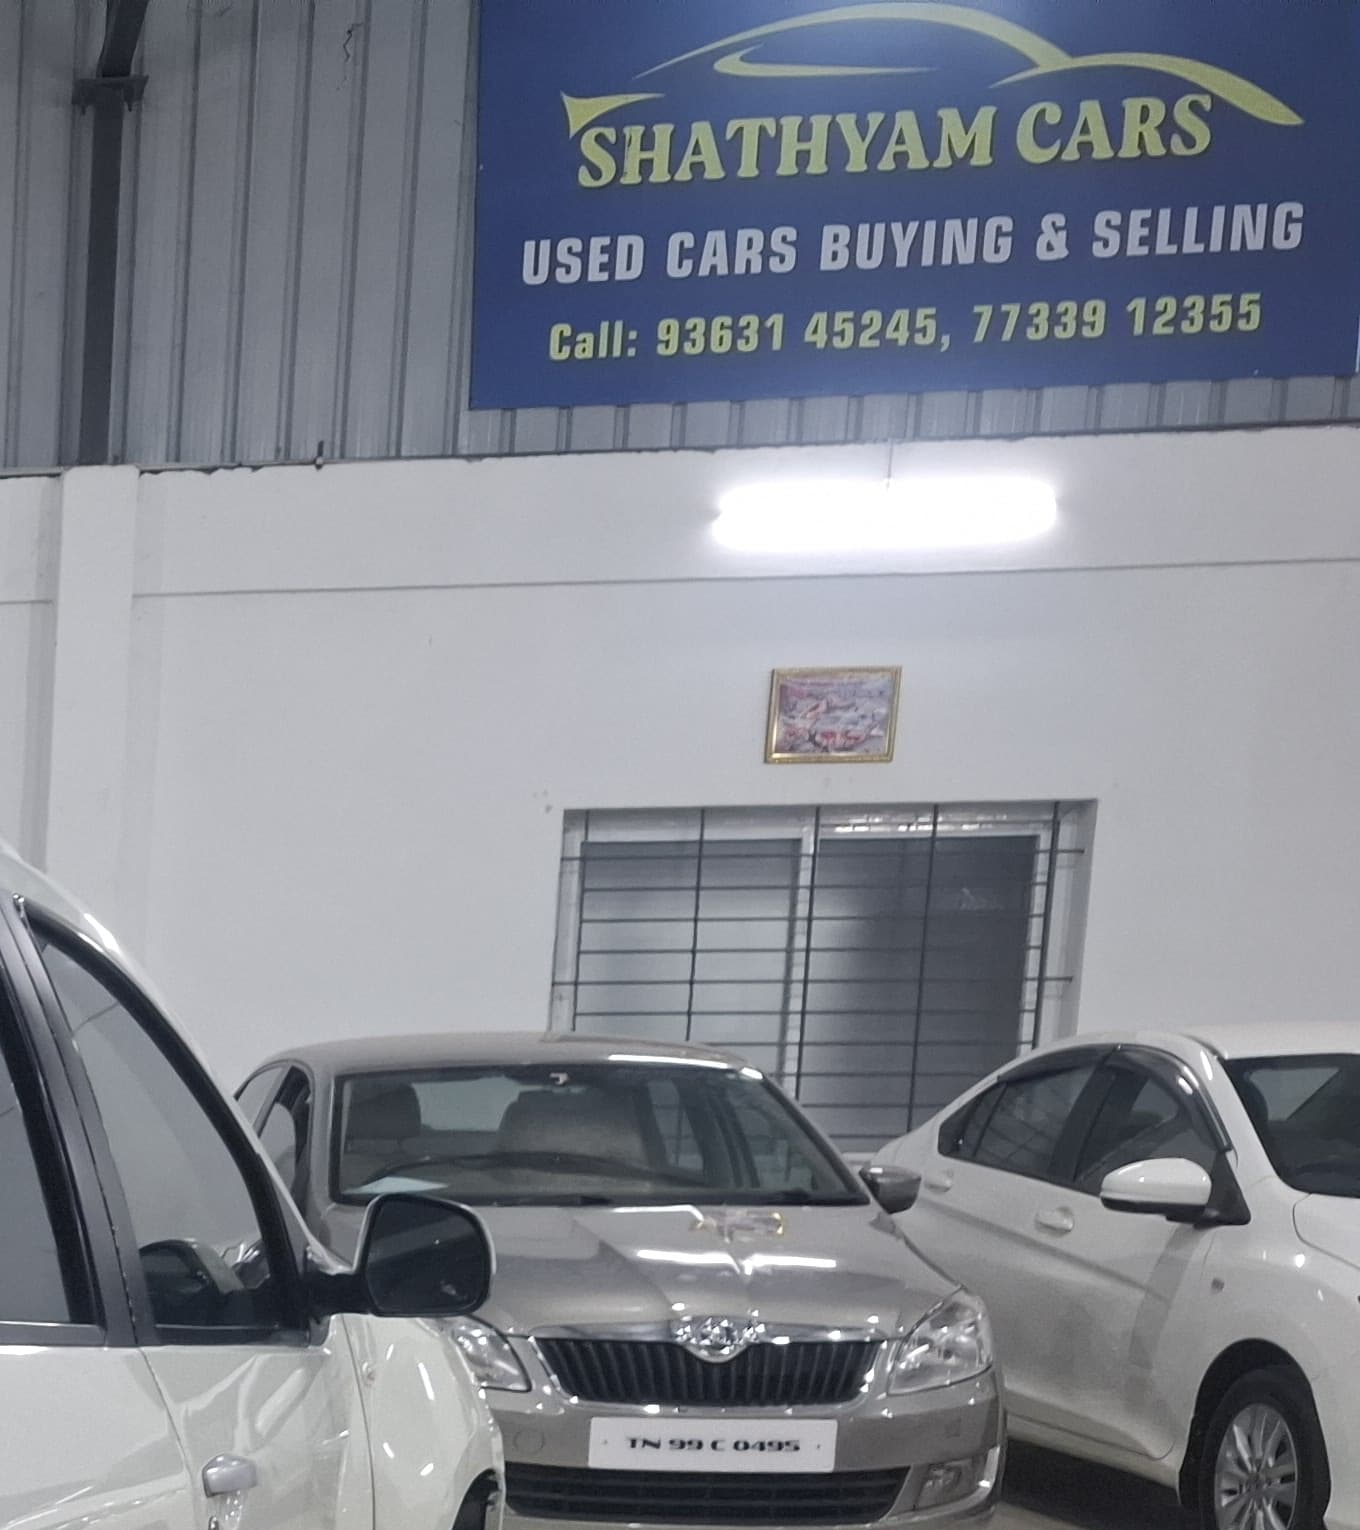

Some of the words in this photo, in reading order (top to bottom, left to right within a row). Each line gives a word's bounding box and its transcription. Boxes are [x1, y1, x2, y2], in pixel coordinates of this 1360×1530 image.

[577, 104, 996, 188] SHATHYAM
[1015, 93, 1214, 163] CARS
[521, 235, 644, 286] USED
[666, 228, 798, 280] CARS
[818, 216, 1014, 273] BUYING
[1036, 213, 1069, 261] &
[1091, 201, 1305, 258] SELLING
[548, 321, 638, 363] Call:
[655, 313, 785, 358] 93631
[803, 305, 951, 354] 45245,
[971, 298, 1106, 346] 77339
[1124, 292, 1263, 337] 12355
[626, 1437, 662, 1450] TN
[668, 1438, 704, 1451] 99
[710, 1439, 726, 1452] C
[732, 1440, 801, 1453] 0495
